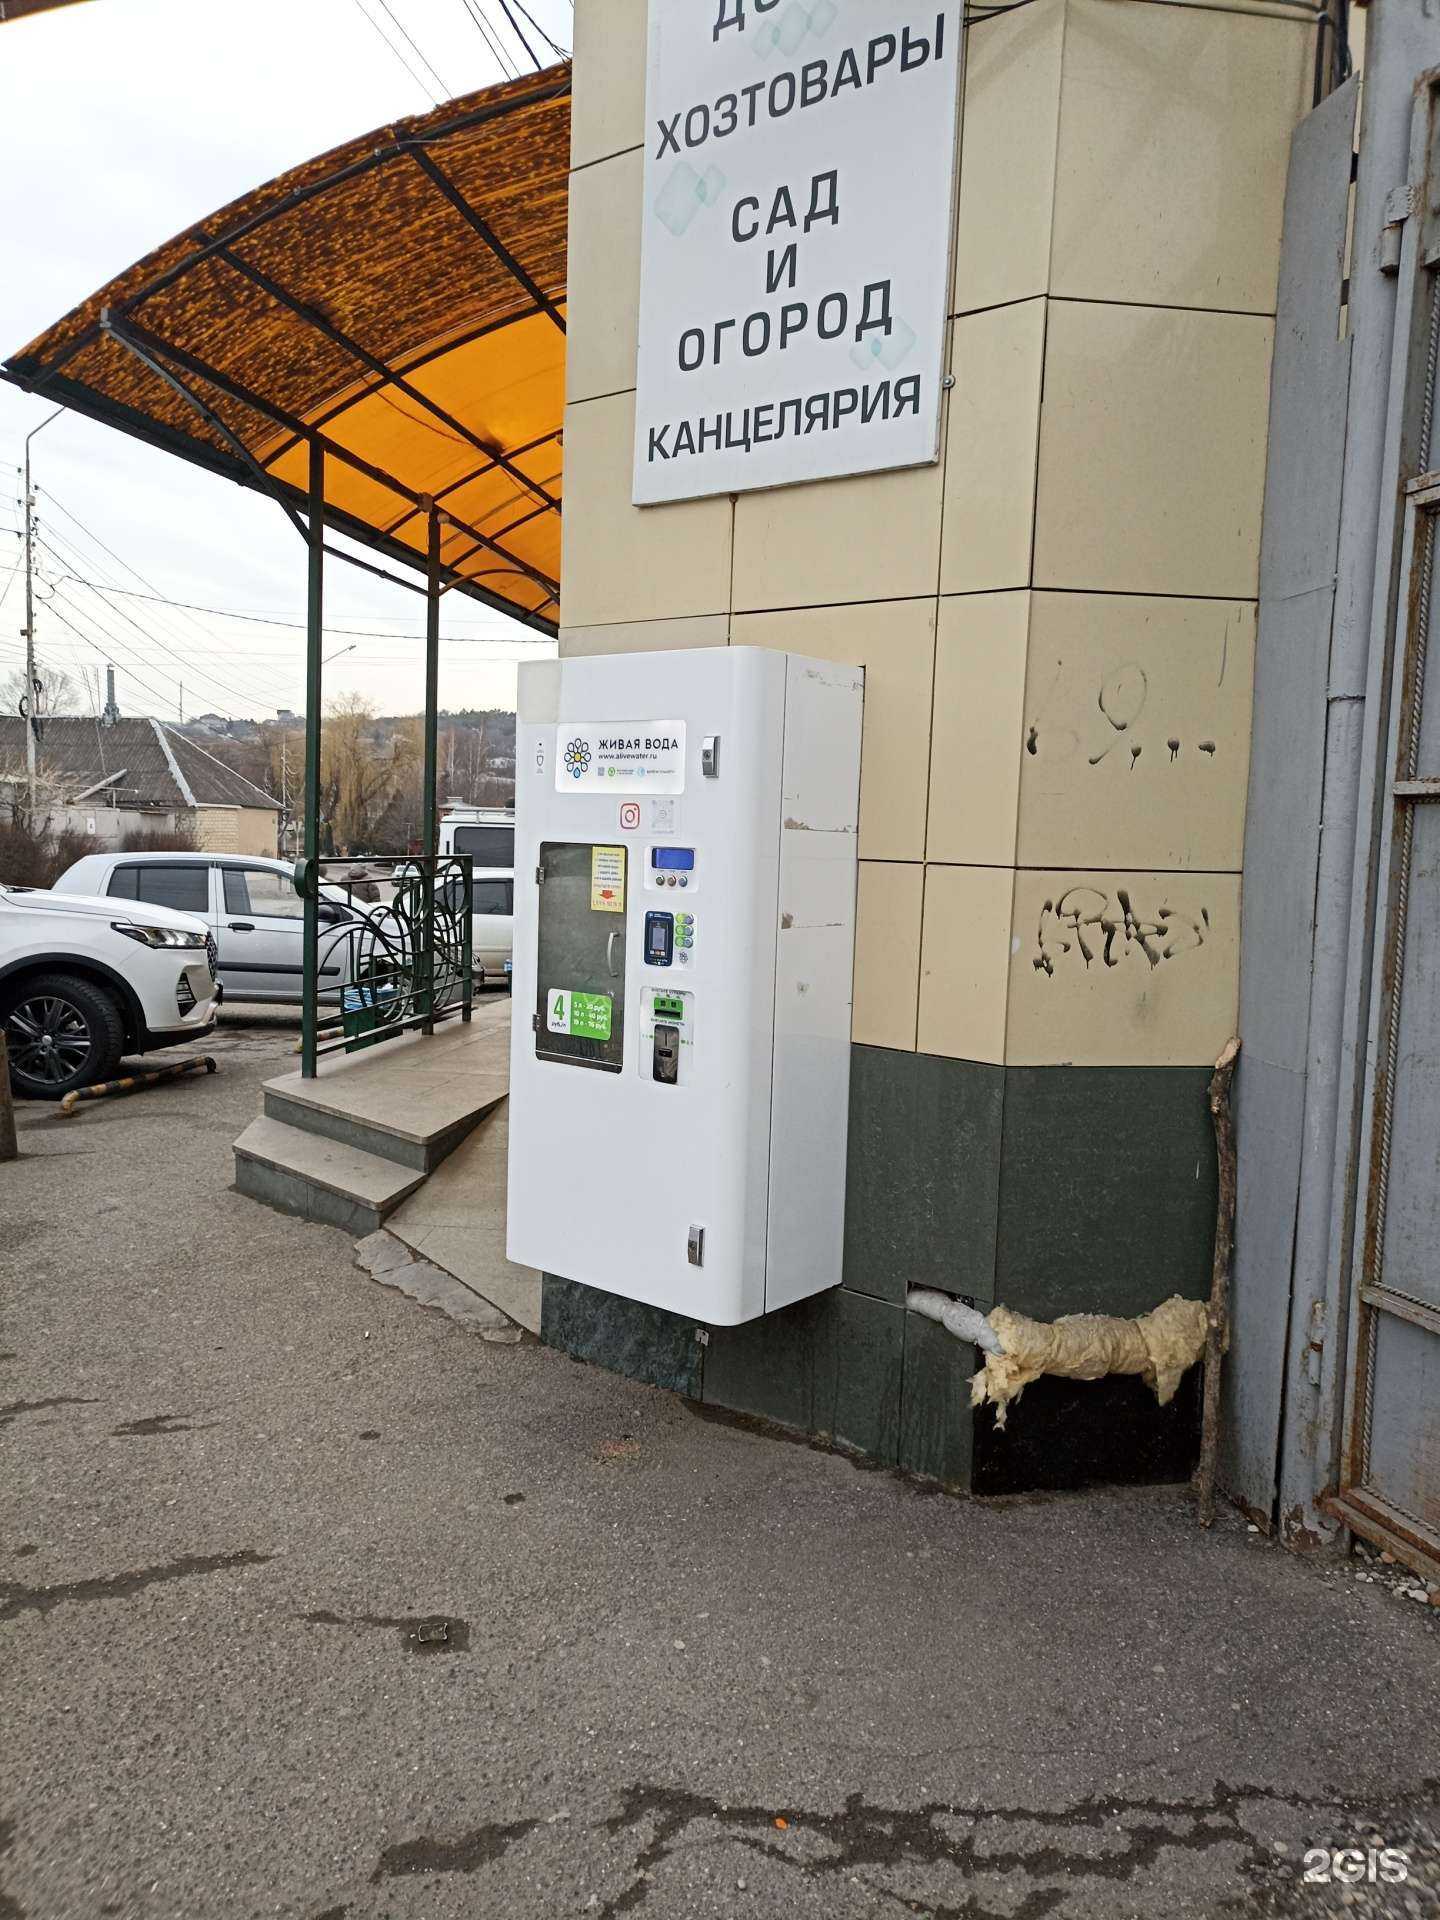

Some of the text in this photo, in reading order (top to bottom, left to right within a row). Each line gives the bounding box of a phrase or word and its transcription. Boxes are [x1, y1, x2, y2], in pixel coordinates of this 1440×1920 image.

[655, 13, 945, 160] ХОЗТОВАРЫ
[732, 170, 839, 242] САД
[766, 243, 797, 293] И
[678, 279, 892, 372] ОГОРОД
[648, 374, 921, 463] КАНЦЕЛЯРИЯ
[599, 738, 678, 750] ЖИВАЯ ВОДА
[554, 994, 564, 1021] 4
